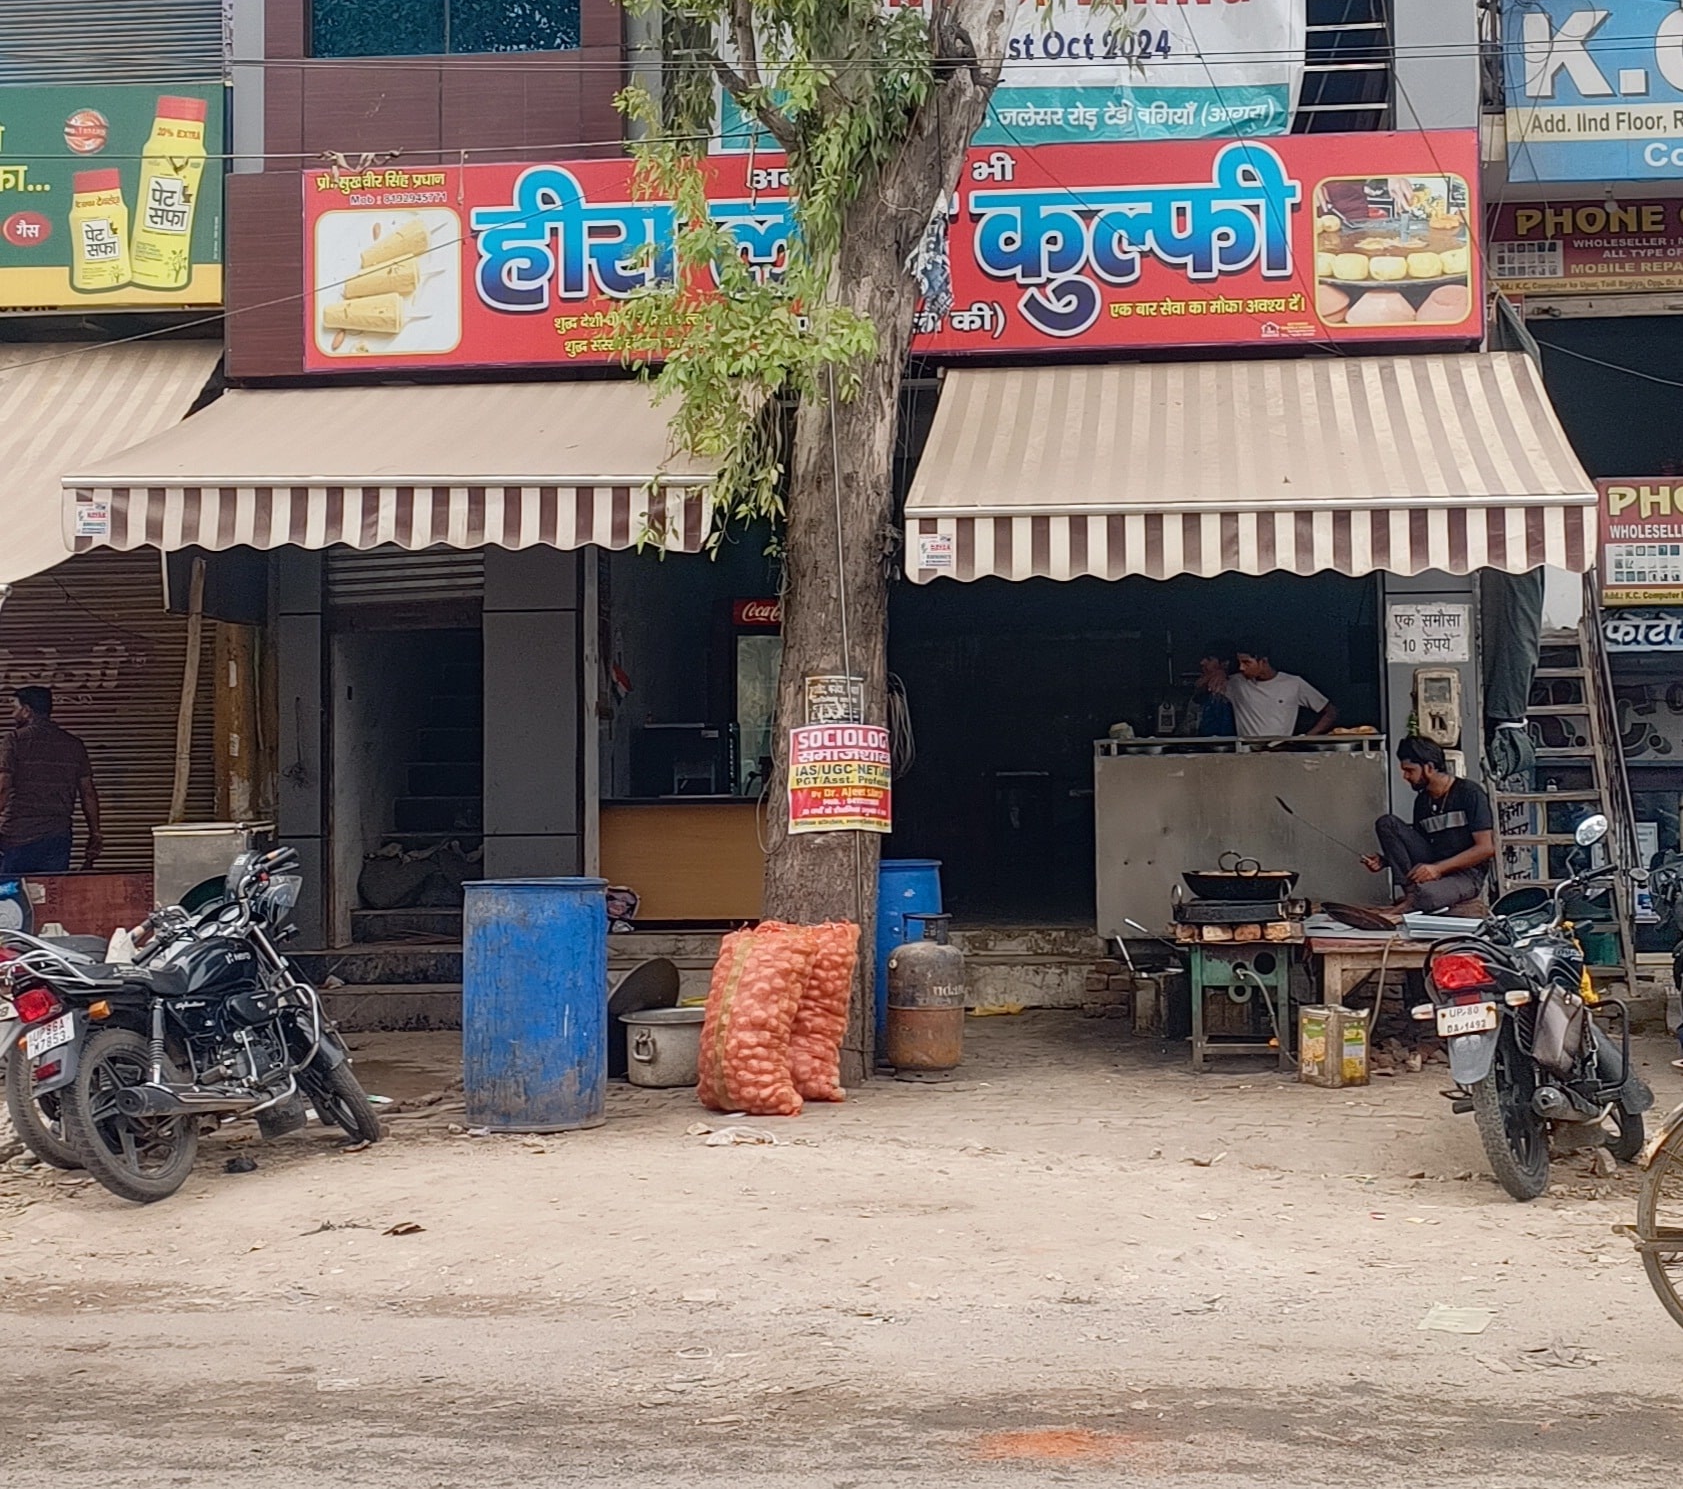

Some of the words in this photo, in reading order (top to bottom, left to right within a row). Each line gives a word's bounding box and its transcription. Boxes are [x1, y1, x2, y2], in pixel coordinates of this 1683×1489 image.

[1042, 30, 1094, 60] Oct
[1102, 29, 1171, 59] 2024
[1530, 113, 1571, 134] Add.
[1616, 110, 1666, 134] Floor,
[971, 151, 1016, 182] भी
[412, 172, 445, 190] प्रधान
[151, 180, 177, 207] पेट
[149, 206, 187, 227] सफा
[1516, 205, 1665, 238] PHONE
[16, 219, 41, 238] गैस
[84, 224, 105, 242] पेट
[968, 141, 1301, 338] कुल्फी
[1573, 237, 1666, 249] WHOLESELLER
[86, 241, 117, 257] सफा
[1602, 249, 1627, 259] ALL
[1631, 248, 1663, 258] TYPE
[1570, 263, 1635, 275] MOBILE
[1110, 302, 1133, 317] एक
[1189, 301, 1207, 315] का
[1610, 524, 1683, 540] WHOLESELL
[1643, 590, 1680, 602] Computer
[1394, 614, 1415, 630] एक
[1402, 638, 1417, 653] 10
